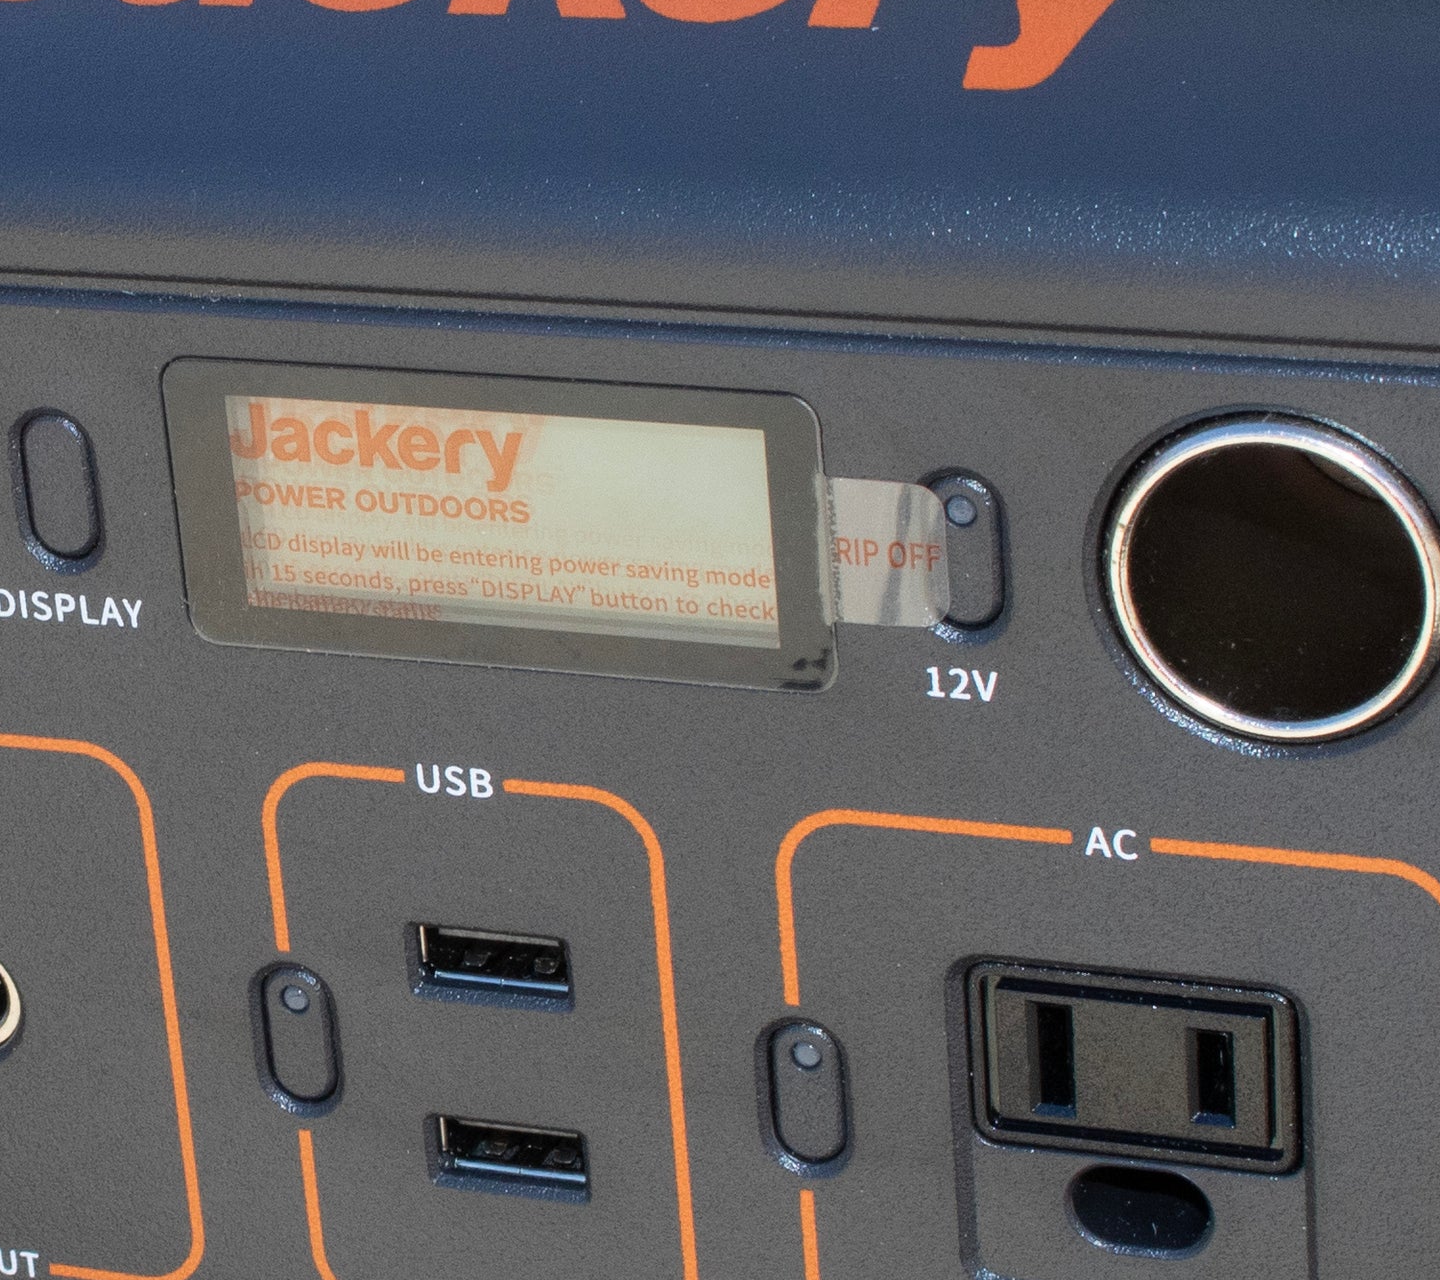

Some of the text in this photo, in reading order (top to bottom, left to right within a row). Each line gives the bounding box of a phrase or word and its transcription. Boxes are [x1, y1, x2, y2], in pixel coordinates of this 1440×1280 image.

[228, 401, 524, 493] Jackery
[234, 479, 532, 524] POWER OUTDOORS
[288, 532, 367, 562] display
[371, 540, 410, 562] will
[416, 543, 444, 563] be
[449, 546, 543, 576] entering
[548, 555, 620, 577] power
[625, 563, 701, 589] saving
[705, 567, 772, 590] mode
[834, 536, 943, 572] RIP OFF
[271, 563, 298, 583] 15
[302, 568, 403, 595] seconds,
[590, 587, 669, 614] button
[675, 595, 700, 616] to
[706, 596, 776, 622] check
[925, 665, 999, 703] 12V
[414, 762, 495, 800] USB
[1084, 826, 1140, 862] AC
